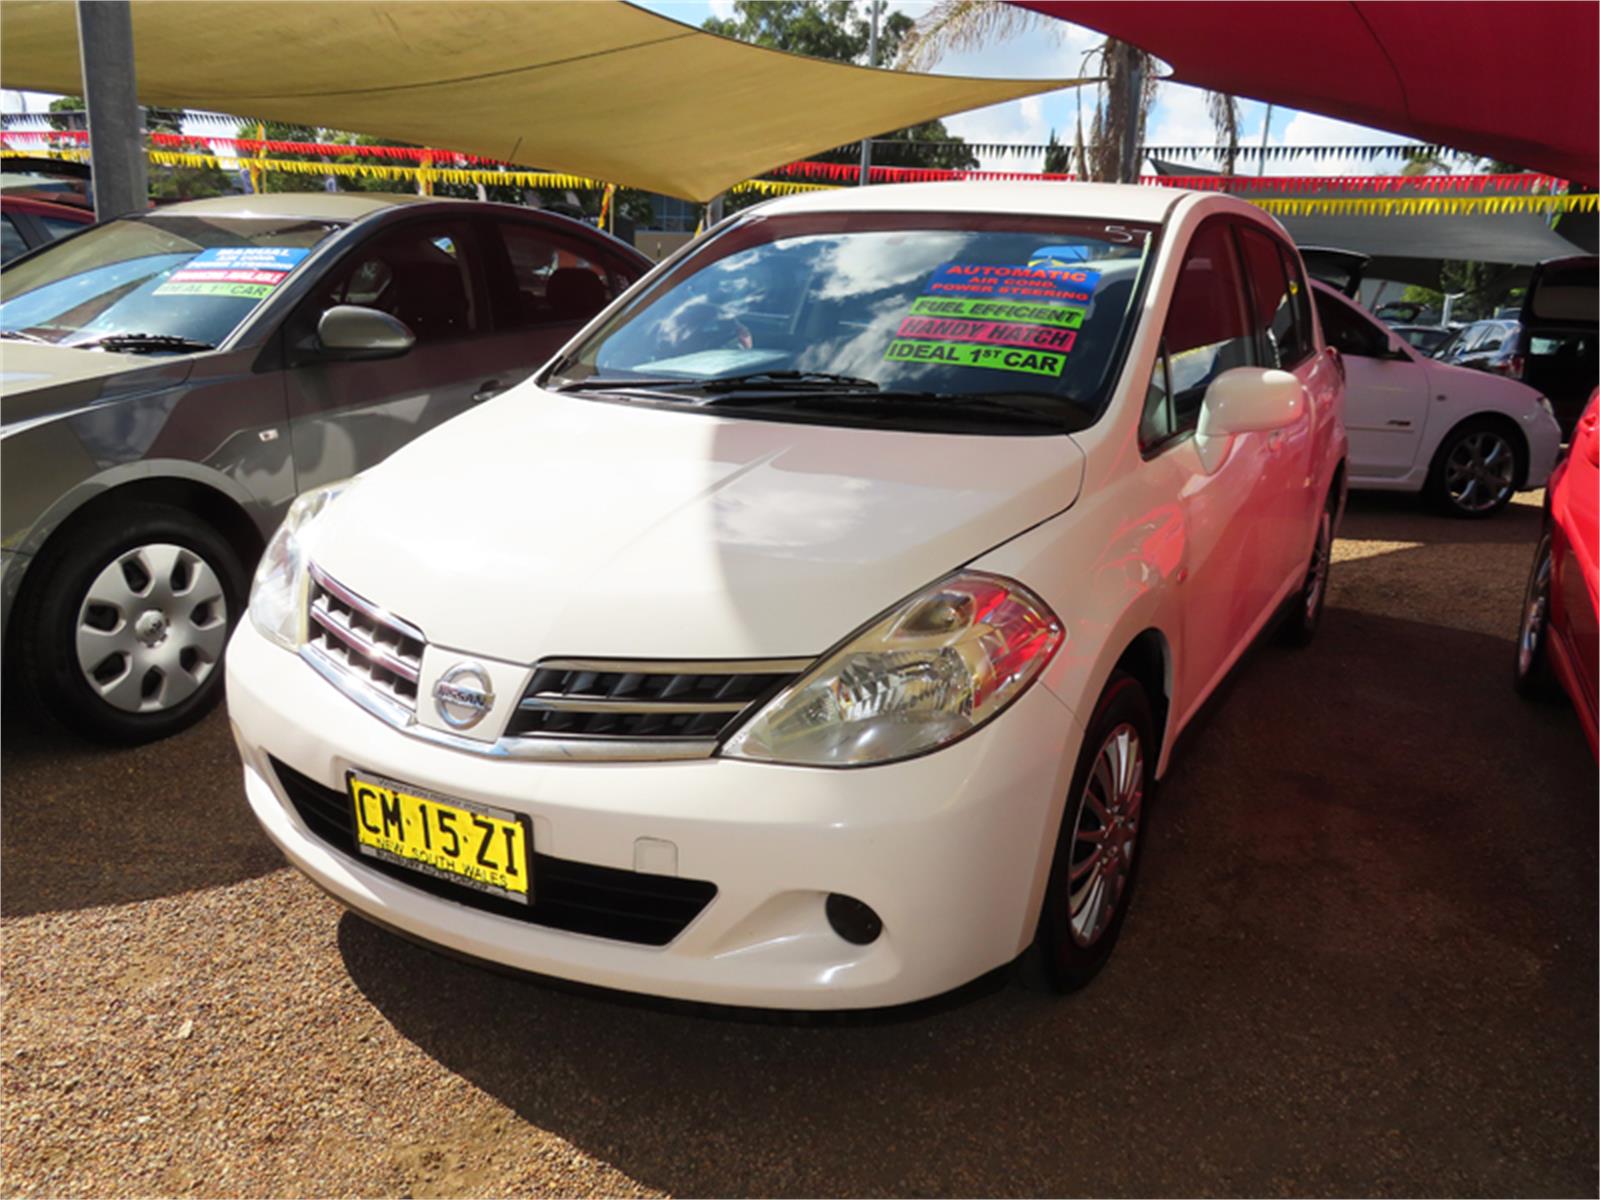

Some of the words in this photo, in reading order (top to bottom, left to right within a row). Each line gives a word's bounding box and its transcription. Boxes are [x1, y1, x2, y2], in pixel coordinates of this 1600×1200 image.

[946, 265, 1088, 283] AUTOMATIC
[968, 276, 1000, 286] AIR
[1003, 277, 1057, 289] COND.
[230, 284, 267, 297] CAR
[931, 283, 993, 293] POWER
[999, 286, 1089, 301] STEERING
[915, 300, 965, 315] FUEL
[969, 302, 1081, 324] EFFICIENT
[901, 317, 985, 338] HANDY
[987, 325, 1070, 347] HATCH
[888, 341, 960, 361] IDEAL
[1003, 352, 1059, 372] CAR
[376, 837, 405, 855] NEW
[411, 847, 457, 870] SOUTH
[463, 863, 509, 888] WALES
